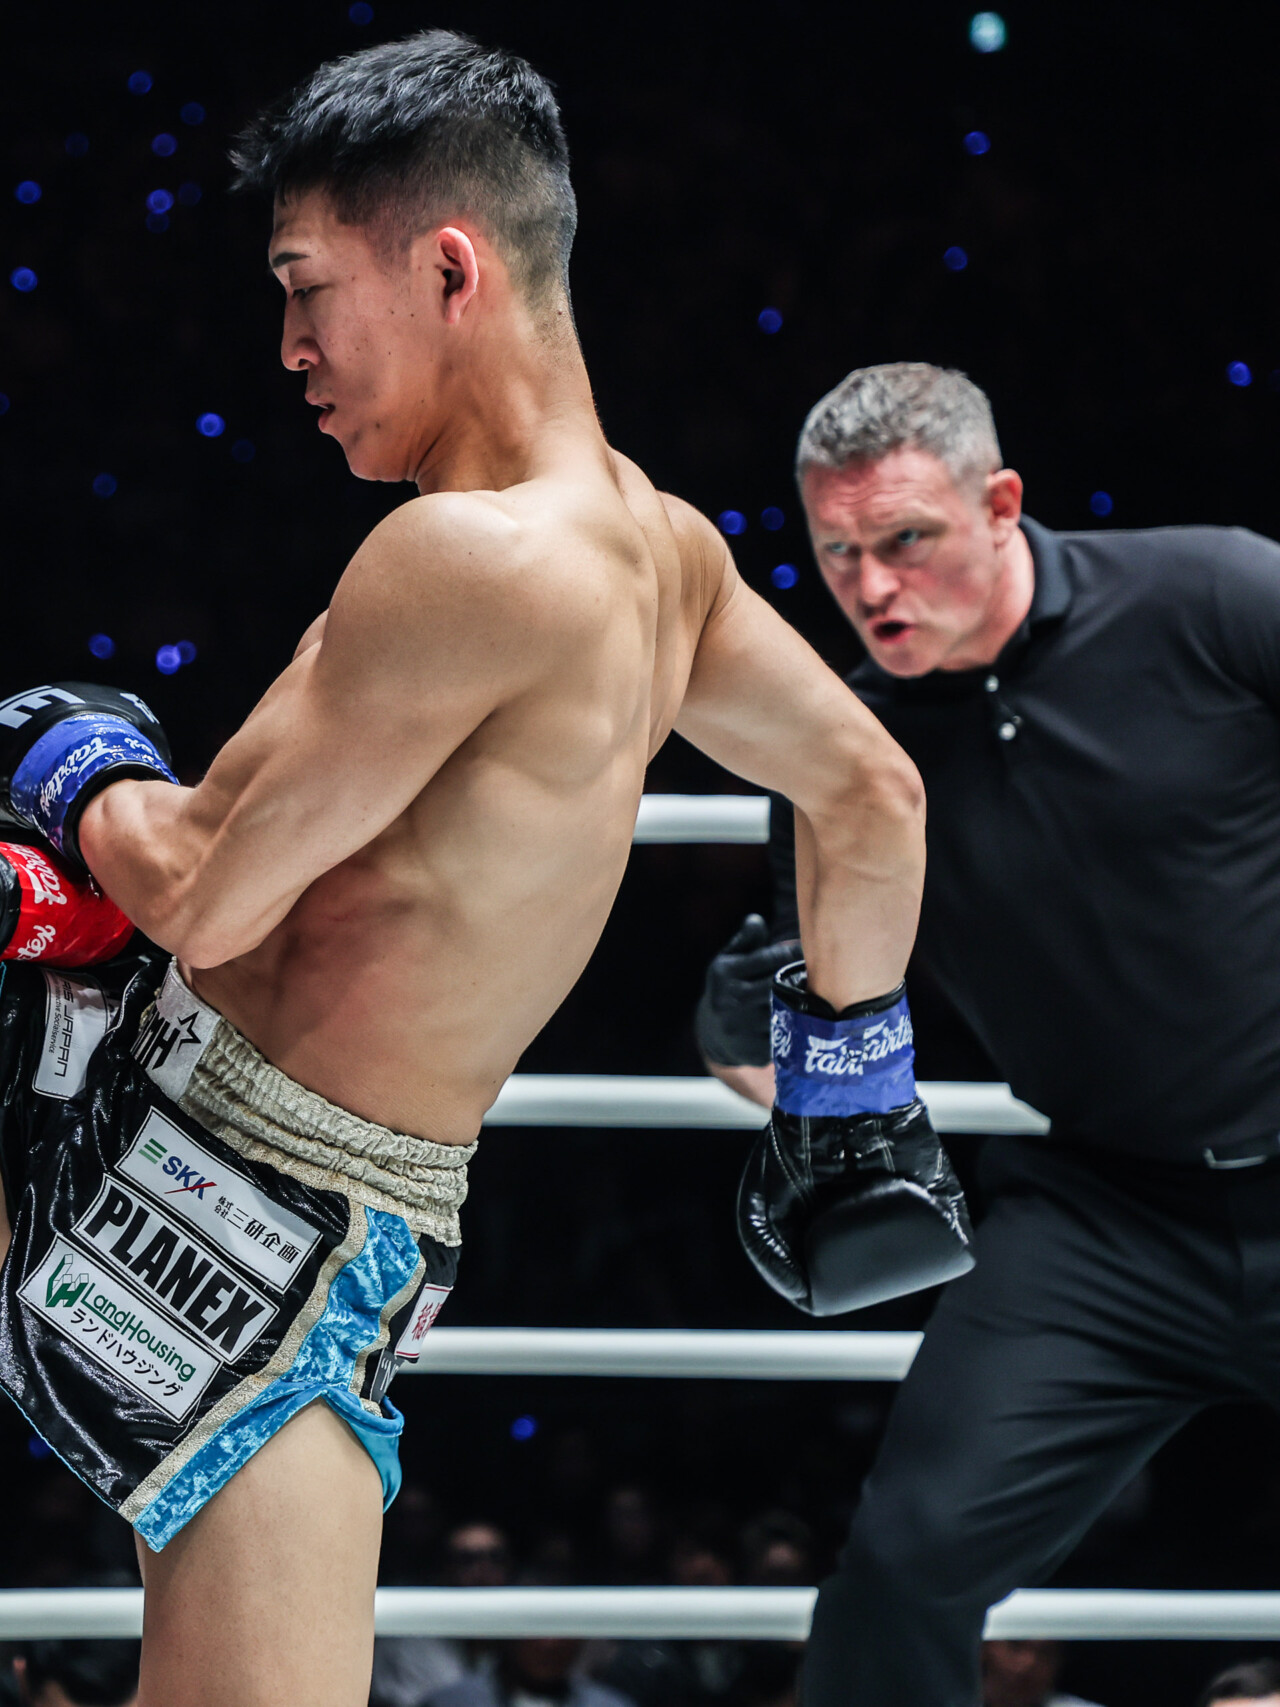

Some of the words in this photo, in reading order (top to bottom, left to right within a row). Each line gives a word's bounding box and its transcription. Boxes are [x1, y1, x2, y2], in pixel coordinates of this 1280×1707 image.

[54, 1005, 75, 1077] JAPAN
[162, 1155, 209, 1200] SKK
[83, 1184, 266, 1354] PLANEX
[71, 1308, 184, 1397] ランドハウジング
[80, 1282, 196, 1383] LandHousing
